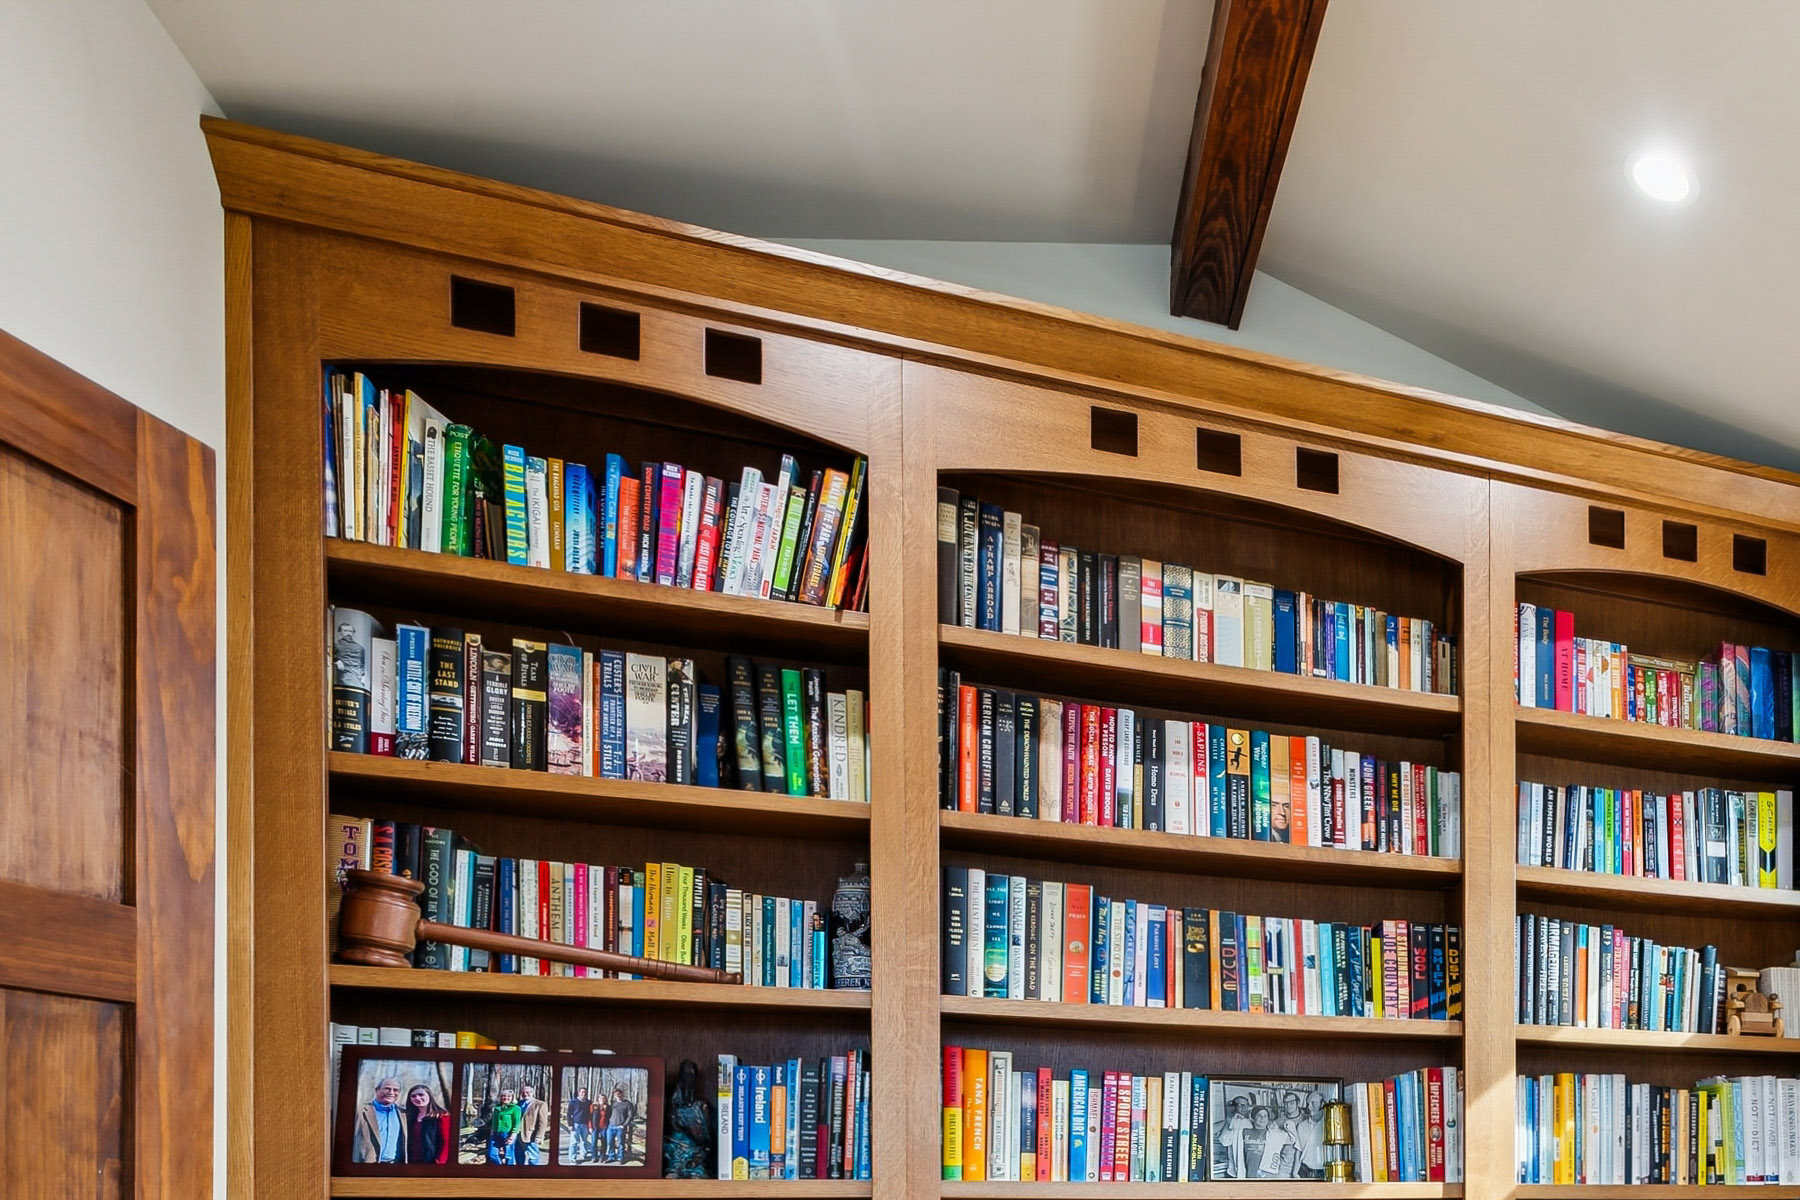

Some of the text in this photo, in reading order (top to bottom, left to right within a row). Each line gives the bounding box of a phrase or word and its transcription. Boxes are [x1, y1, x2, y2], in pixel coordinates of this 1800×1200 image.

[426, 456, 435, 480] BASSET
[644, 467, 652, 484] DOWN
[425, 483, 434, 512] HOUND
[449, 442, 462, 550] ETIQUETTE FOR YOUNG PEOPLE
[504, 463, 526, 558] BAD ACTORS
[642, 515, 650, 531] ROAD
[642, 534, 650, 548] MICK
[964, 520, 975, 560] JOURNEY
[986, 545, 994, 577] TRAMP
[406, 660, 422, 680] BATTLE
[440, 661, 454, 669] THE
[469, 647, 478, 680] LINCOLN
[603, 662, 612, 688] TRIALS
[613, 660, 622, 693] CUSTER'S
[406, 681, 422, 693] CRY
[434, 679, 459, 688] STAND
[406, 702, 422, 730] FREEDOM
[670, 683, 679, 726] CUSTER
[787, 694, 799, 744] LET THEM
[833, 699, 846, 762] KINDRED
[982, 693, 991, 792] AMERICAN CRUCIFIXION
[603, 744, 611, 770] STILES
[811, 706, 821, 792] The Anxious Generation
[1196, 732, 1204, 772] SAPIENS
[1363, 762, 1374, 811] JOHN GREEN
[1324, 818, 1332, 838] Crow
[429, 863, 439, 884] GOD
[551, 878, 561, 930] ANTHEM
[1029, 943, 1036, 954] ON
[1548, 922, 1560, 991] ARMAGEDDON
[1384, 934, 1398, 1008] JOE COUNTRY
[1398, 987, 1409, 1009] WALL
[755, 1086, 766, 1124] Ireland
[975, 1077, 983, 1104] TANA
[1072, 1074, 1084, 1136] AMERICAN DIRT
[1429, 1082, 1440, 1123] IMPEACHERS
[721, 1103, 729, 1134] IRELAND
[1118, 1089, 1130, 1165] SPOOK STREET
